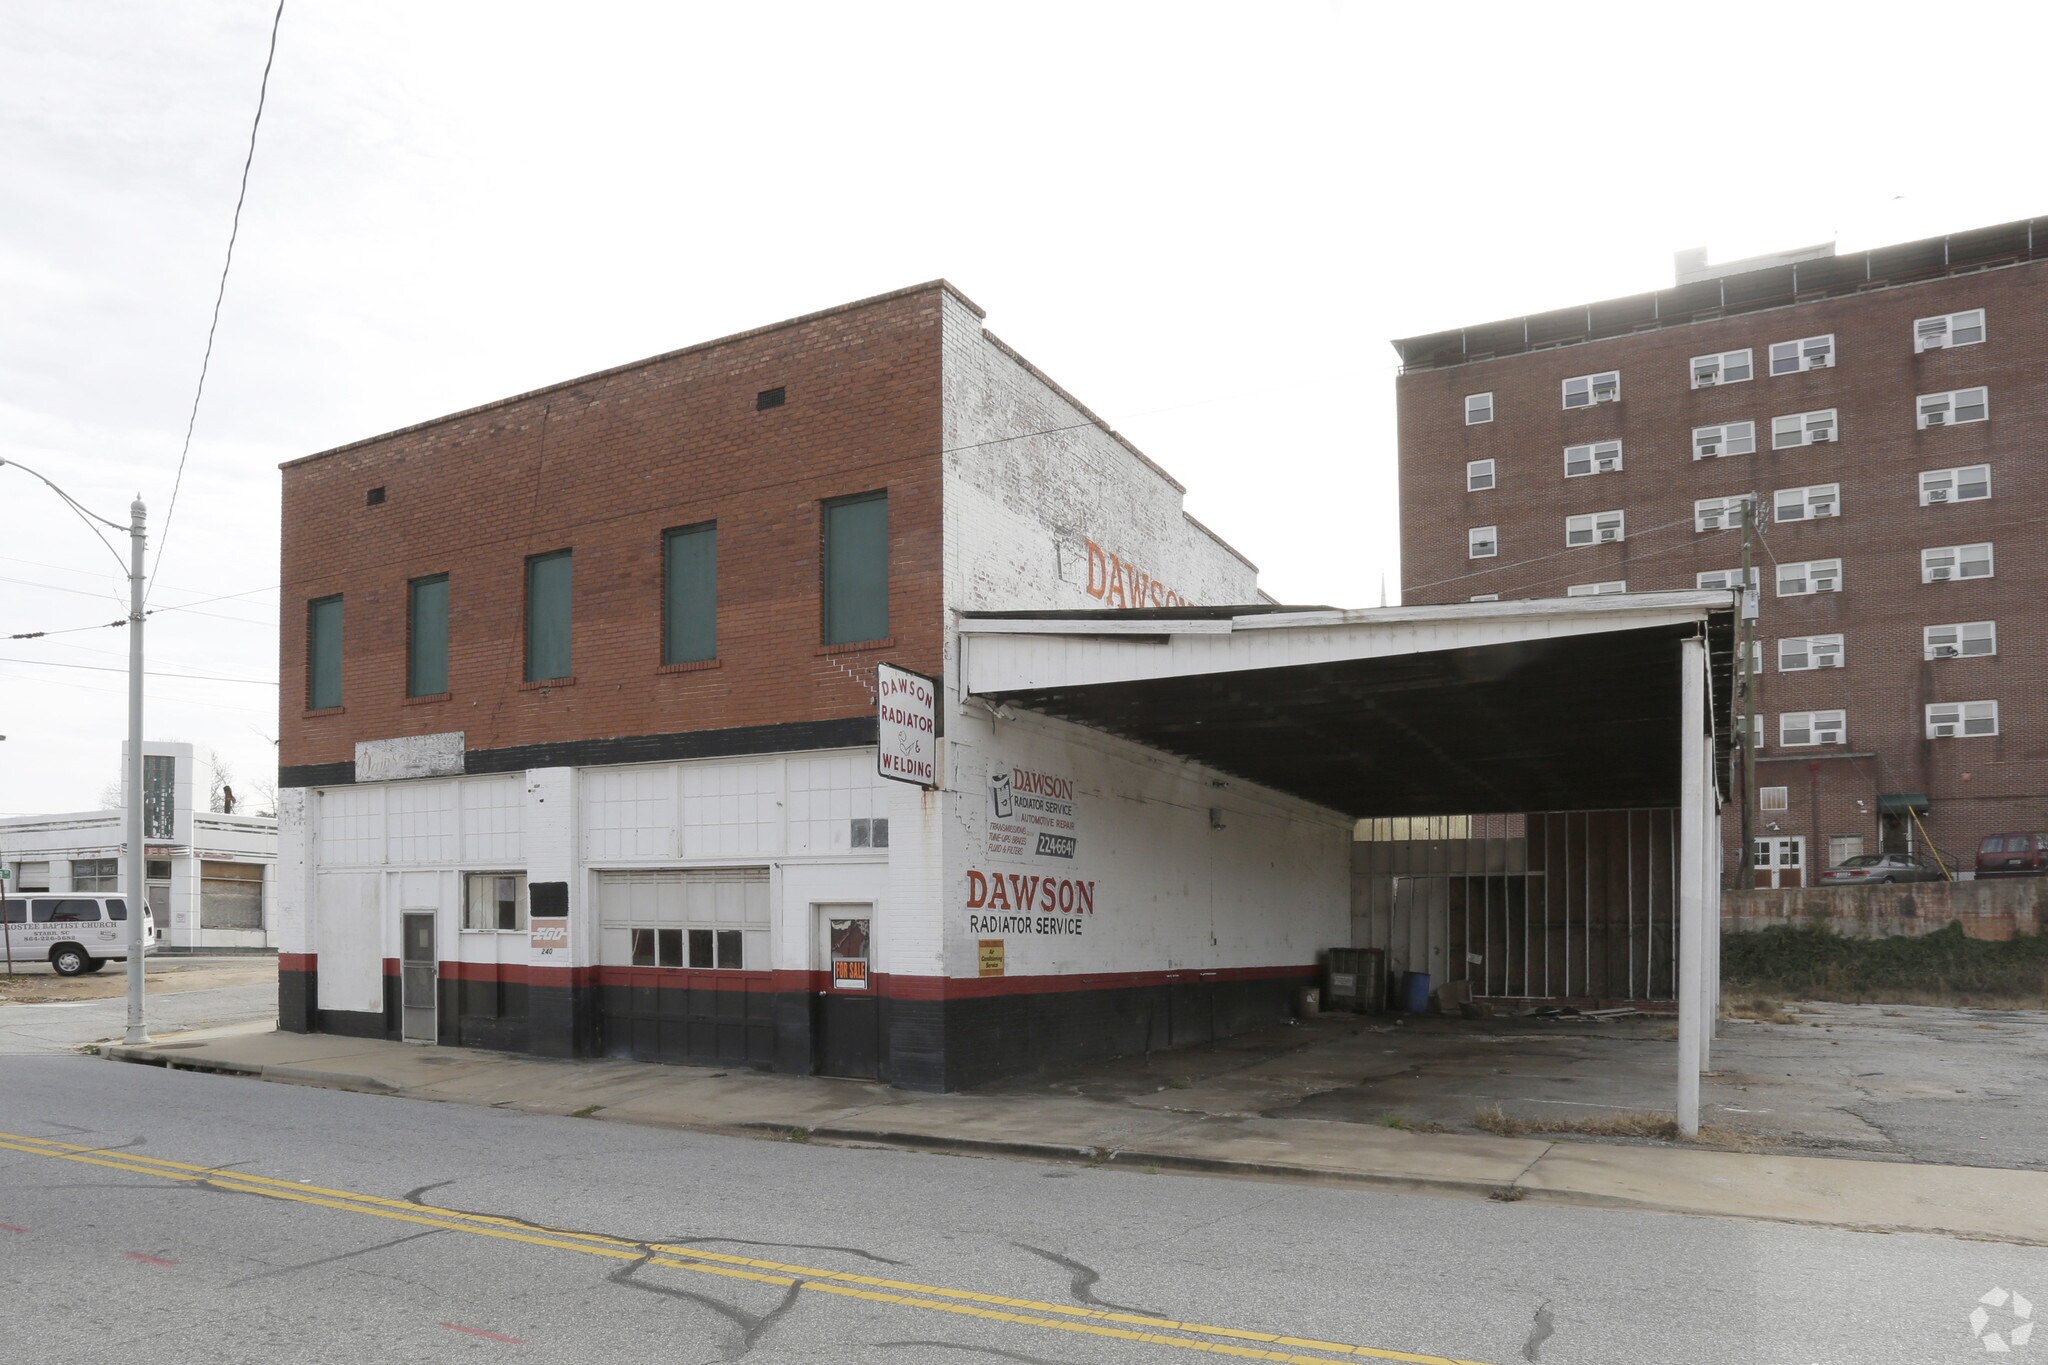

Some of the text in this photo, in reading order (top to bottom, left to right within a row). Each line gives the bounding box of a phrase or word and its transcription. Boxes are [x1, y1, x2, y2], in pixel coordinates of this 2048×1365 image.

[1084, 537, 1196, 609] DAWS
[881, 677, 932, 709] DAWSON
[881, 705, 933, 733] RADIATOR
[882, 752, 932, 778] WELDING
[1012, 768, 1073, 801] DAWSON
[1014, 796, 1072, 815] RADIATOR SERVICE
[1021, 813, 1076, 831] AUTOMOTIVE REPAIR
[966, 870, 1095, 914] DAWSON
[42, 922, 79, 930] BAPTIST
[81, 921, 117, 929] CHURCH
[970, 915, 1082, 935] RADIATOR SERVICE
[836, 961, 865, 979] FOR SALE
